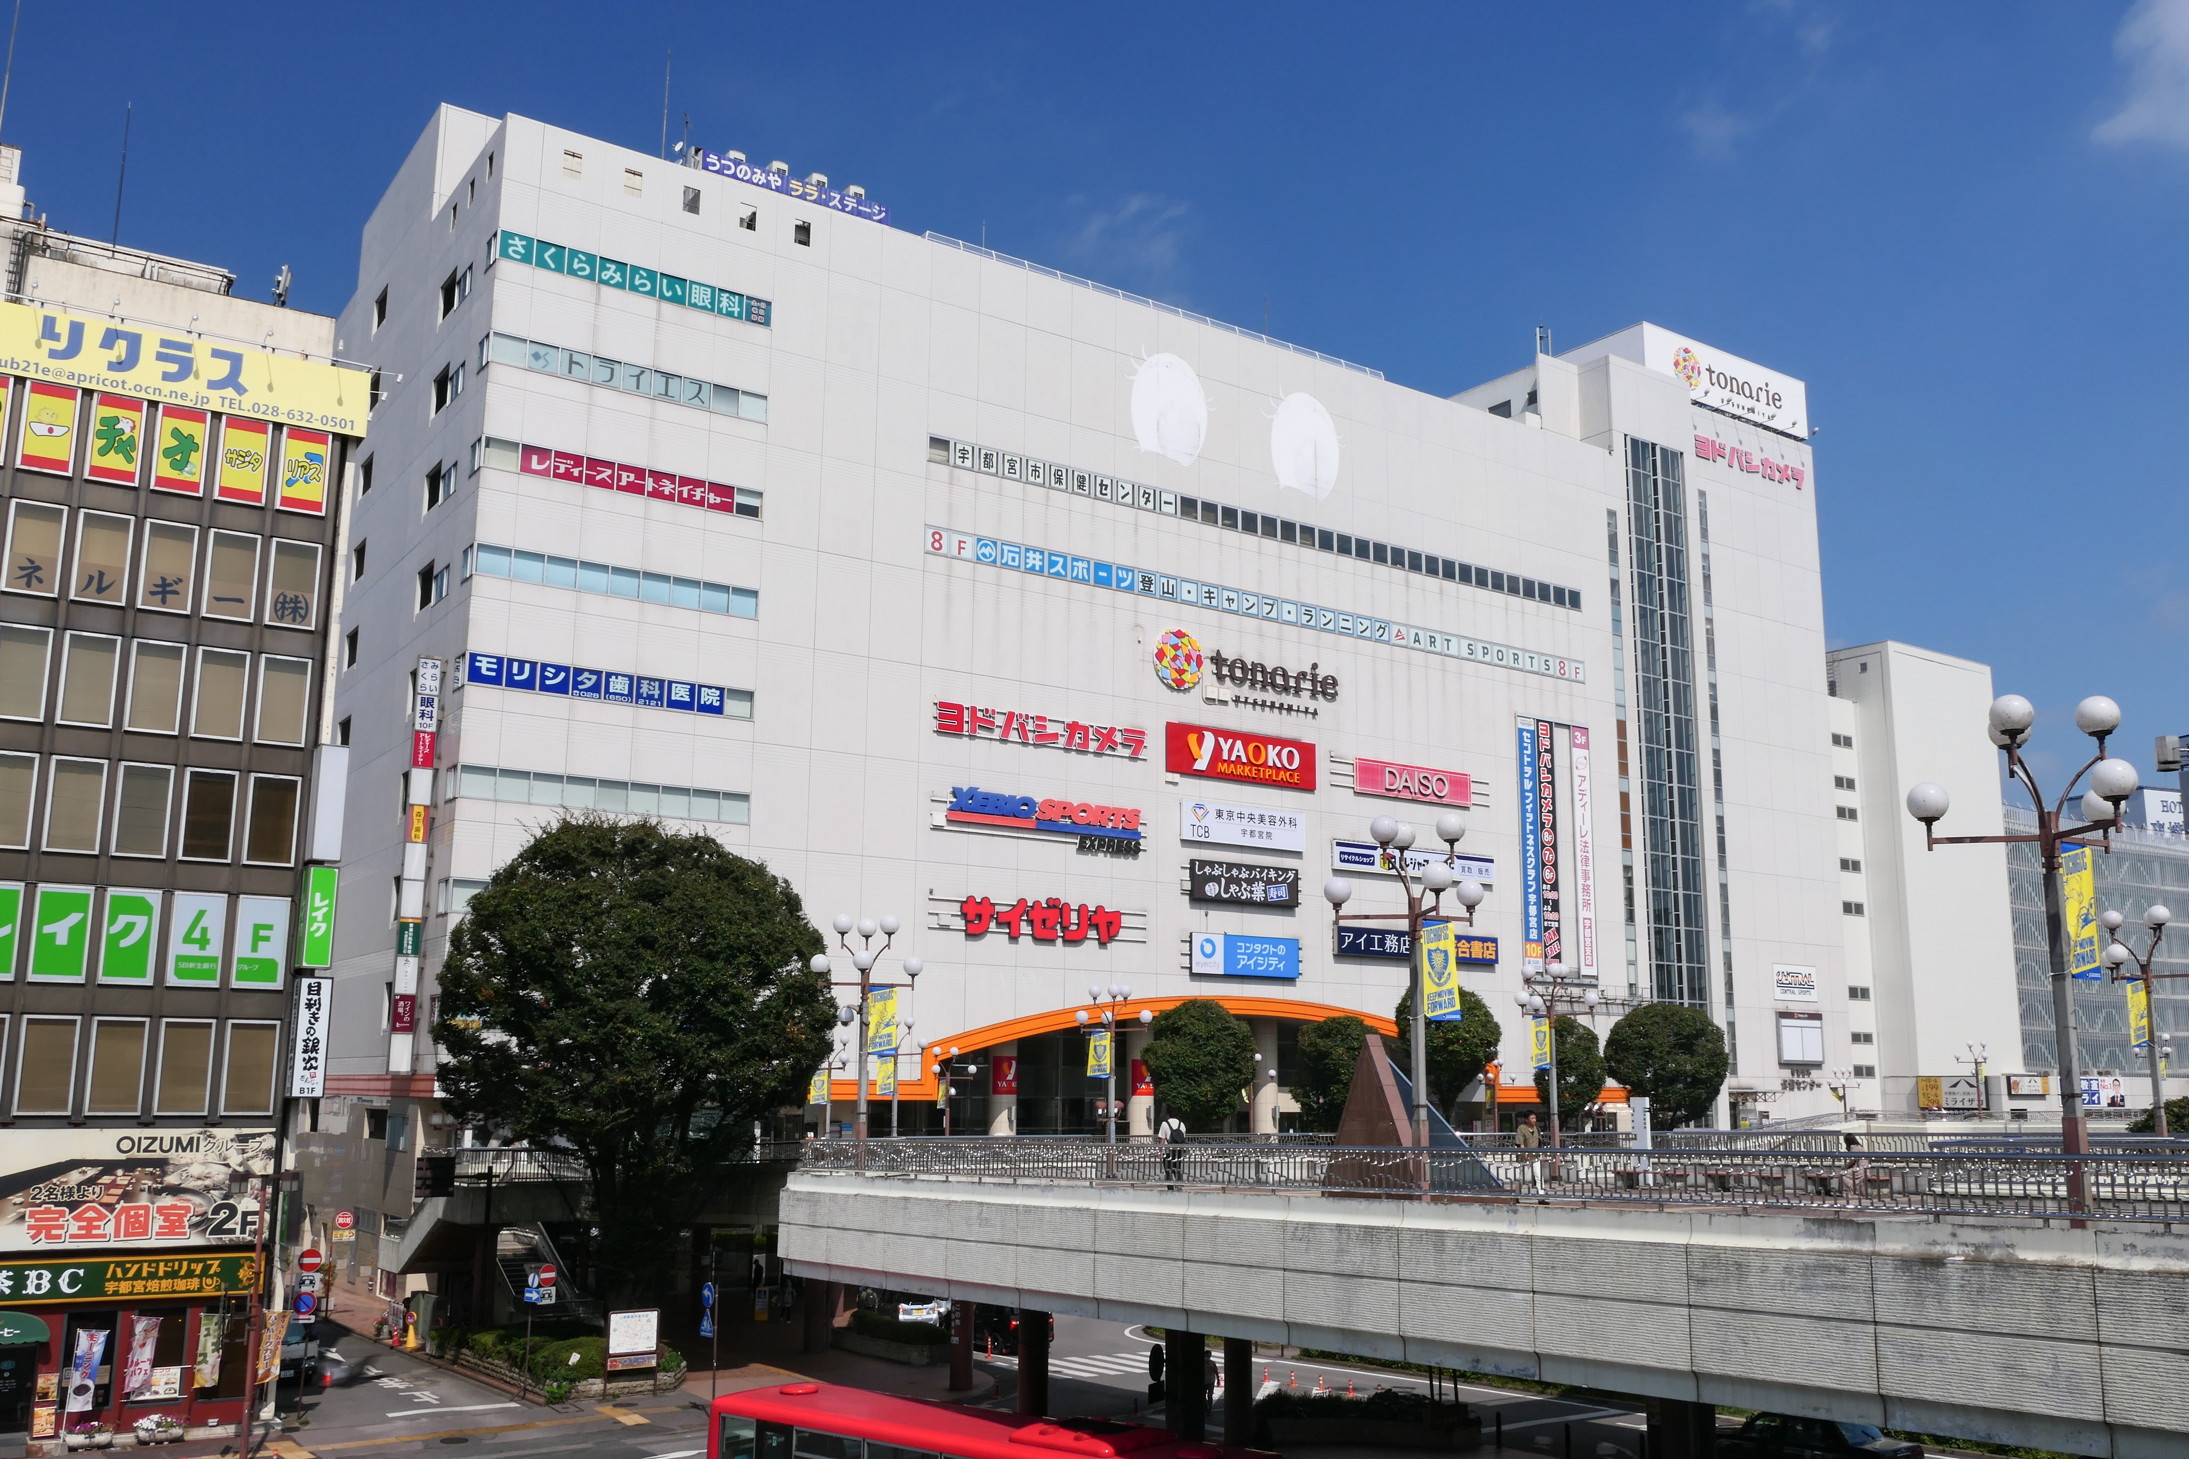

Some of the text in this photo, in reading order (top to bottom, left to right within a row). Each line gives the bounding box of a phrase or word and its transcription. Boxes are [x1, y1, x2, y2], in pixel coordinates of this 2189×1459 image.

[706, 154, 886, 222] うつのみや ララ・ステージ
[506, 235, 740, 319] さくらみらい眼科
[41, 314, 249, 397] リクラス
[566, 351, 706, 406] トライエス
[1705, 364, 1782, 410] tonarie
[219, 394, 356, 432] TEL.028-632-0501
[225, 448, 264, 472] サジタ
[1694, 433, 1805, 490] ヨドバシカメラ
[530, 453, 733, 505] レディースアートネイチャー
[957, 446, 1174, 511] 宇都宮市保健センター
[930, 530, 967, 556] 8F
[1001, 543, 1133, 589] 石井スポーツ
[1413, 631, 1452, 652] ART
[1466, 642, 1551, 672] SPORTS
[474, 656, 721, 707] モリシタ歯科医院
[1210, 649, 1340, 702] tonarie
[418, 696, 435, 722] 眼科
[580, 690, 662, 708] 028 (650) 2121
[418, 722, 434, 730] 10F
[936, 700, 1147, 758] ヨドバシカメラ
[1574, 731, 1587, 745] 3F
[1217, 736, 1301, 769] YAOKO
[1217, 761, 1300, 784] MARKETPLACE
[1384, 766, 1449, 798] DAISO
[1538, 722, 1553, 828] ヨドバシカメラ
[948, 786, 1142, 830] XEBIO SPORTS
[1214, 808, 1298, 829] 東京中央美容外科
[1190, 824, 1210, 839] TCB
[1240, 828, 1273, 841] 宇都宮院
[1577, 774, 1592, 912] アディーレ法律事務所
[1078, 835, 1141, 856] EXPRESS
[1340, 854, 1374, 864] リサイクルショップ
[1195, 861, 1296, 883] しゃぶしゃぶバイキング
[1221, 878, 1266, 902] しゃぶ葉
[1268, 886, 1287, 900] 寿司
[310, 892, 329, 938] レイク
[961, 895, 1122, 943] サイゼリヤ
[1236, 942, 1286, 955] コンタクトの
[1543, 927, 1559, 946] TAX
[1454, 940, 1497, 961] 合書店
[1526, 943, 1542, 957] 10F
[1545, 941, 1561, 958] FREE
[1236, 955, 1286, 971] アイシティ
[1427, 997, 1456, 1014] FORWARD
[301, 981, 322, 1072] 目利きの銀次
[299, 1087, 316, 1095] B1F
[116, 1135, 267, 1154] OIZUMI グループ
[30, 1184, 104, 1202] 2名様より
[26, 1201, 260, 1243] 完全個室 2F
[105, 1259, 222, 1279] ハンドドリップ
[104, 1277, 201, 1295] 宇都宮焙煎珈琲
